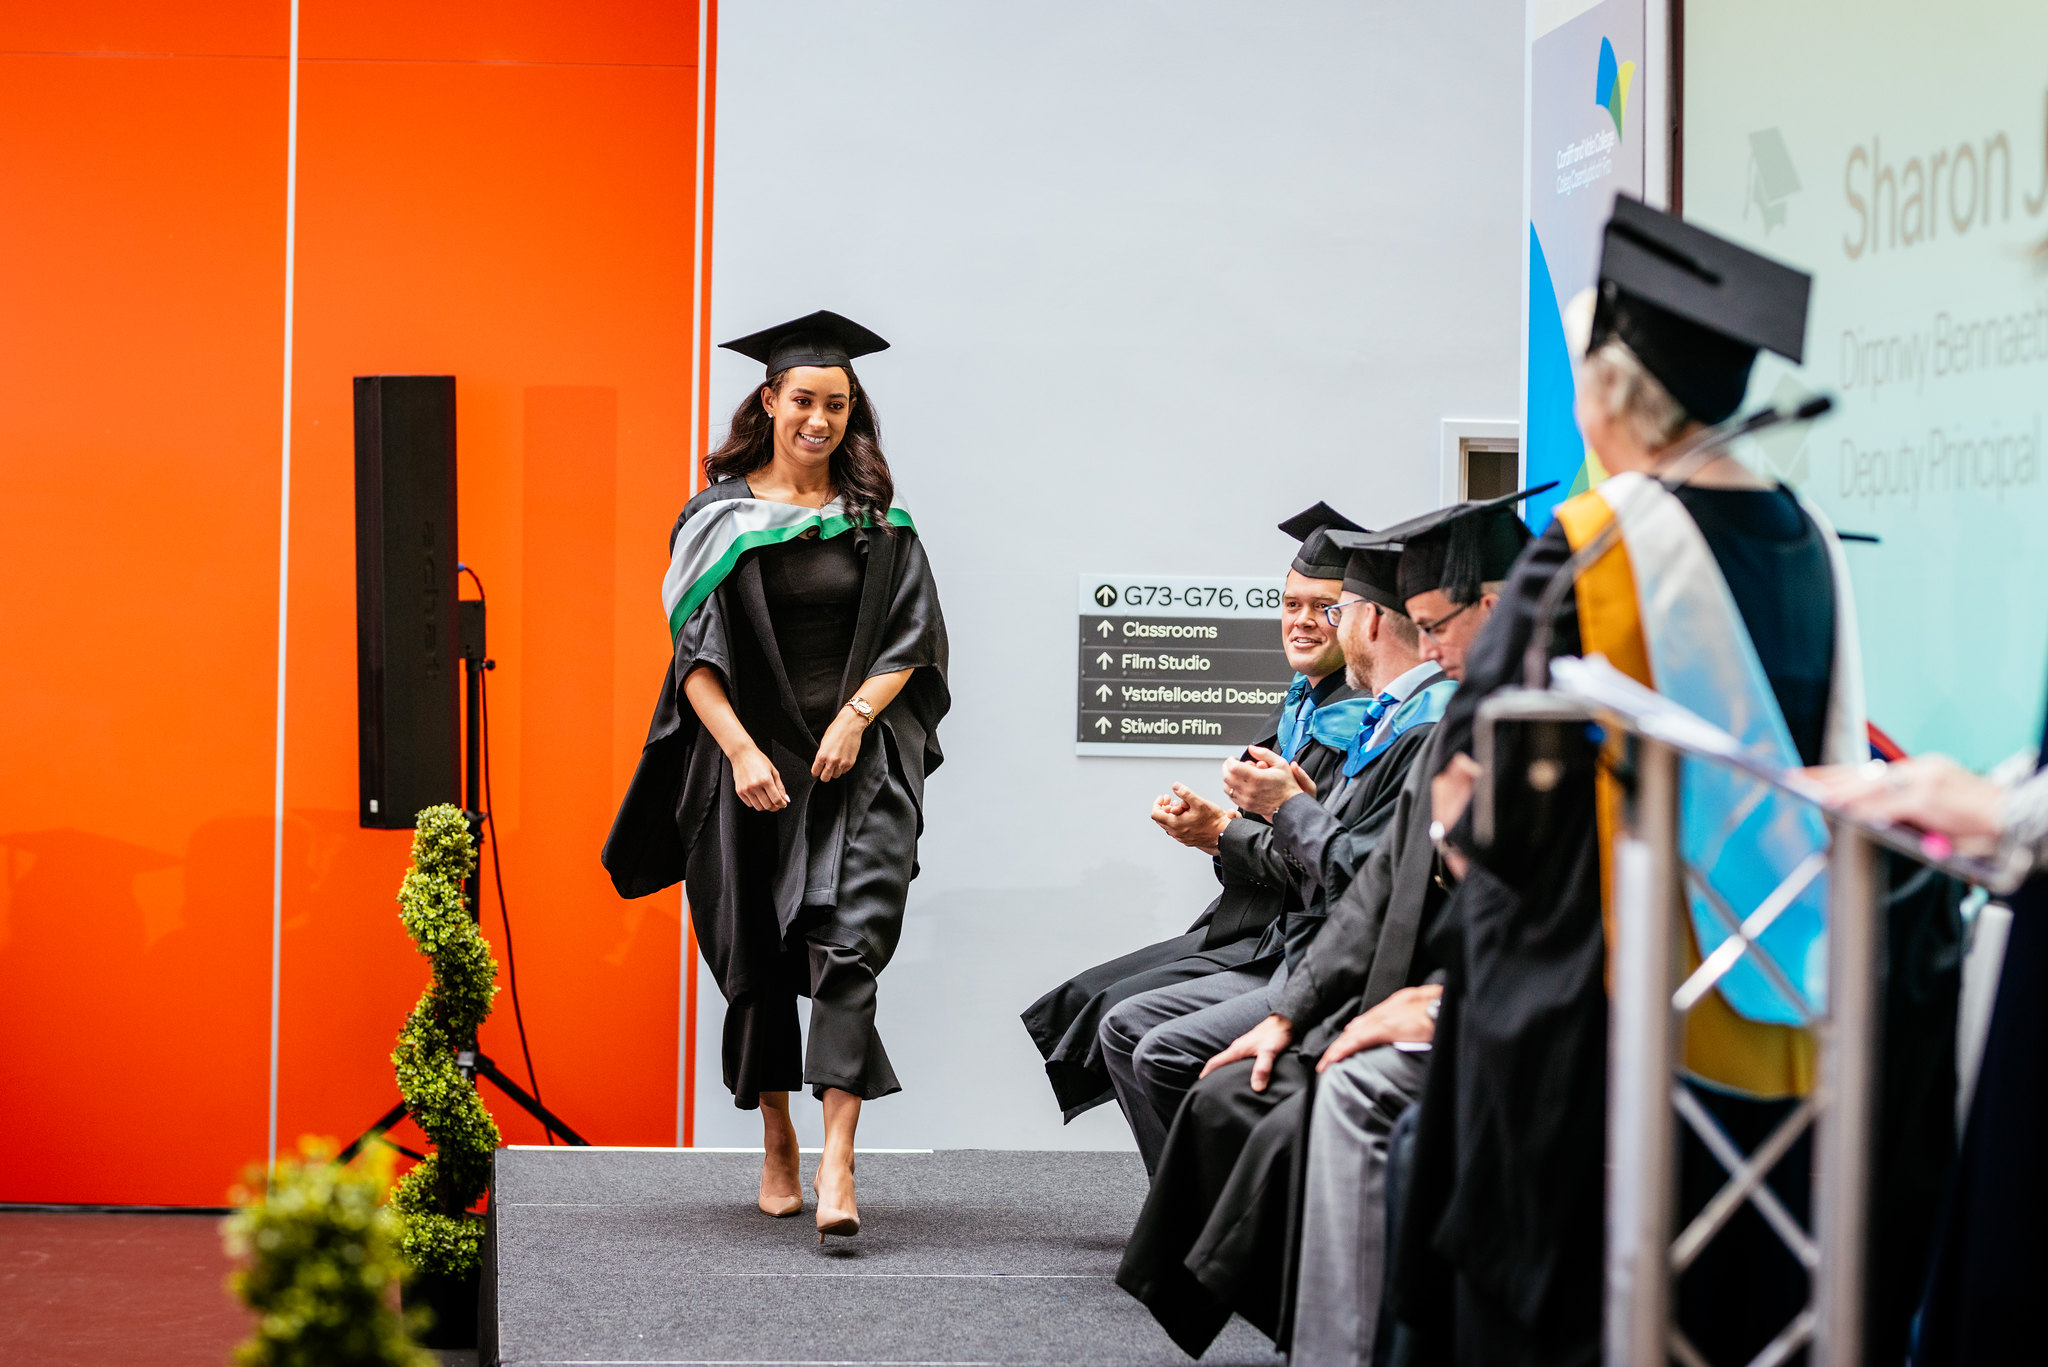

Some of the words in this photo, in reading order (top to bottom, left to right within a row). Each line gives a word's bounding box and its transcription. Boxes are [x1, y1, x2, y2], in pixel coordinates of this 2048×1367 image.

[1842, 129, 2012, 262] Sharon
[1933, 296, 2048, 378] Bennaet
[1838, 436, 1926, 513] Deputy
[1927, 409, 2044, 504] Principal
[1124, 585, 1239, 611] G73-G76,
[1245, 588, 1281, 609] G8
[1122, 621, 1218, 640] Classrooms
[1121, 653, 1156, 671] Film
[1157, 654, 1211, 671] Studio
[1120, 685, 1223, 704] Ystafelloedd
[1120, 717, 1180, 735] Stiwdio
[1181, 719, 1222, 736] Ffilm
